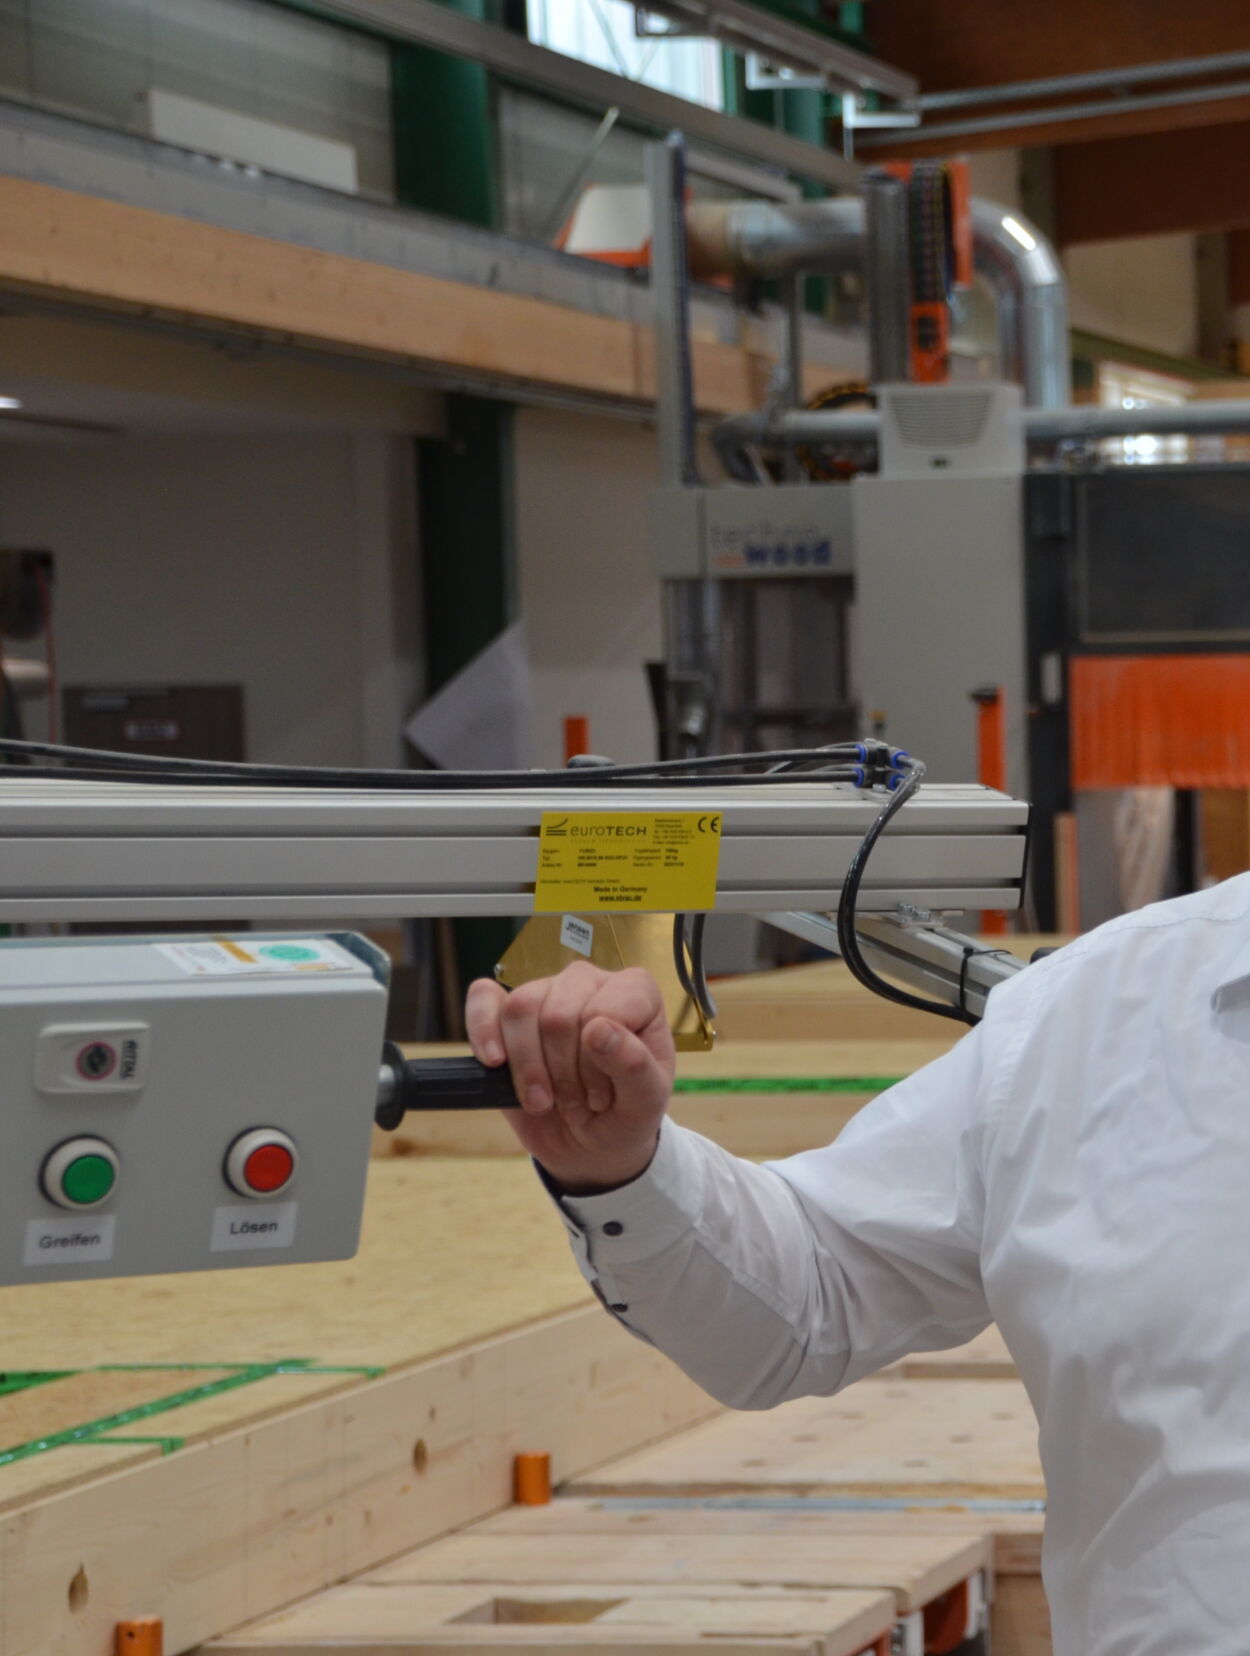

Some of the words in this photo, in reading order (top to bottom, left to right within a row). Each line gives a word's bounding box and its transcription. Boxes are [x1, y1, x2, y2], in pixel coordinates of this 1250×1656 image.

[744, 539, 832, 565] wood
[570, 825, 647, 837] euroTECH
[121, 1039, 138, 1081] RITTAL
[229, 1218, 279, 1235] Lösen
[38, 1232, 101, 1250] Greifen
